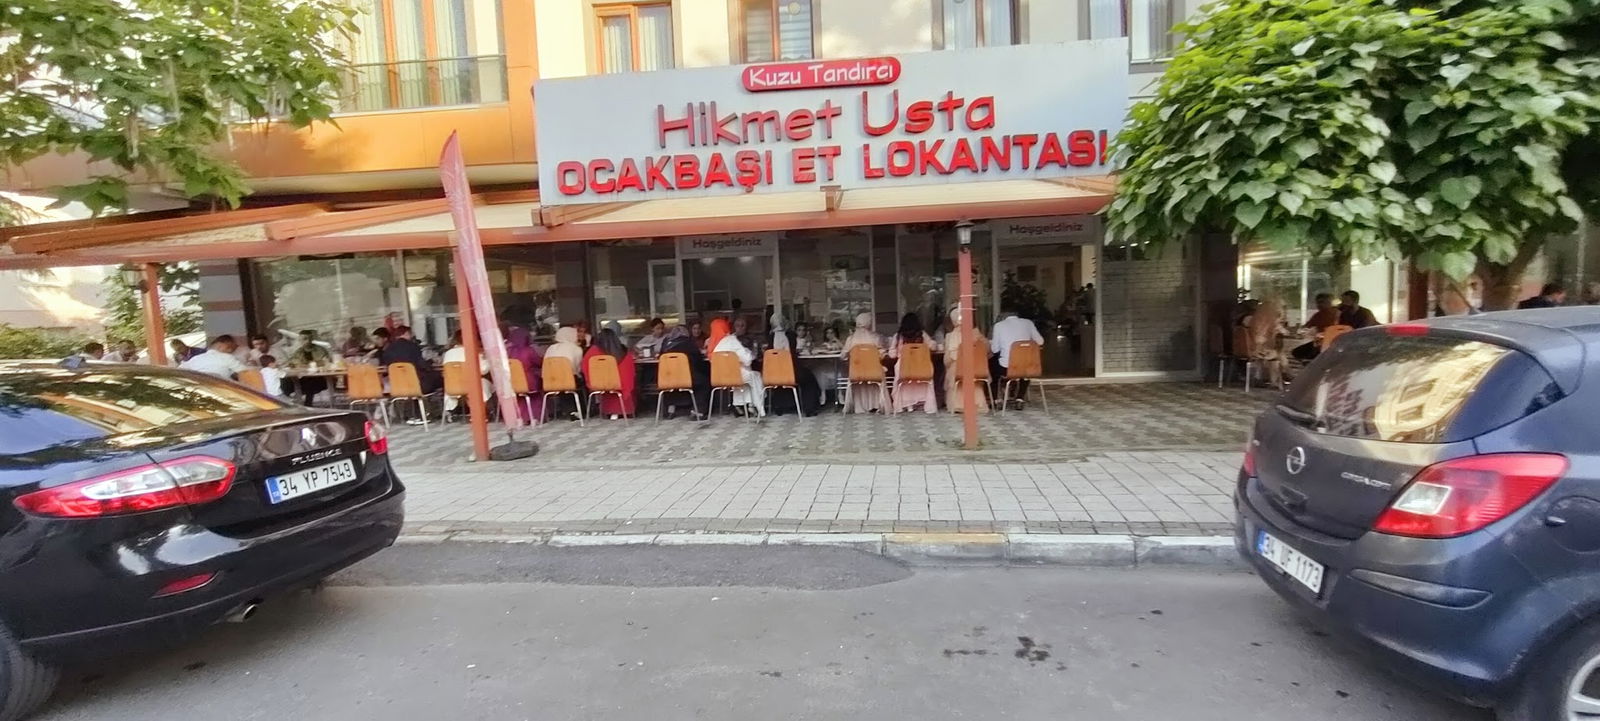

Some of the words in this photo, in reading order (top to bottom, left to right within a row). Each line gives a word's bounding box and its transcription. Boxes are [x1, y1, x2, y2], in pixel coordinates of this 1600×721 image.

[749, 67, 801, 87] Kuzu
[808, 62, 893, 84] Tandırcı
[656, 99, 842, 149] Hikmet
[860, 88, 995, 136] Usta
[557, 149, 775, 193] OCAKBAŞI
[791, 144, 842, 184] ET
[862, 129, 1107, 179] LOKANTASI
[279, 477, 298, 496] 34
[302, 471, 318, 490] YP
[322, 462, 353, 485] 7549
[1263, 535, 1275, 559] 34
[1294, 555, 1321, 588] 1173
